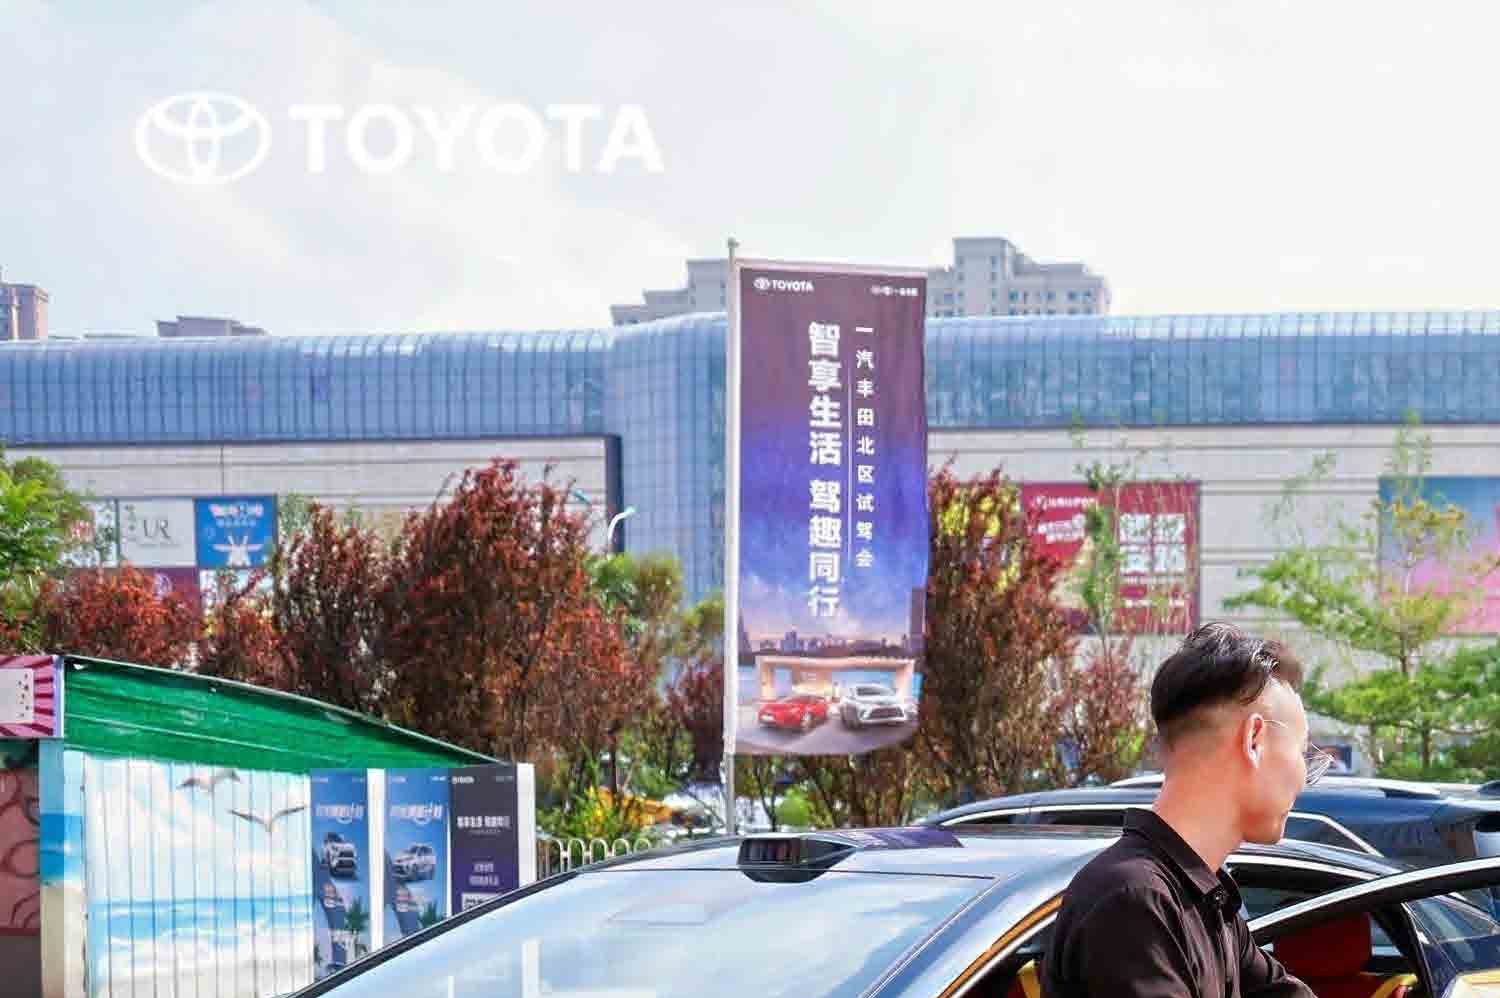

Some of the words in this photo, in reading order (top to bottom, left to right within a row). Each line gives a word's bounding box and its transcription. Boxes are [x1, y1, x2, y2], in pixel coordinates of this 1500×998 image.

[771, 279, 815, 293] TOYOTA
[807, 322, 842, 466] 智享生活
[855, 325, 875, 568] 一汽丰田北区试驾会
[807, 479, 842, 617] 驾趣同行
